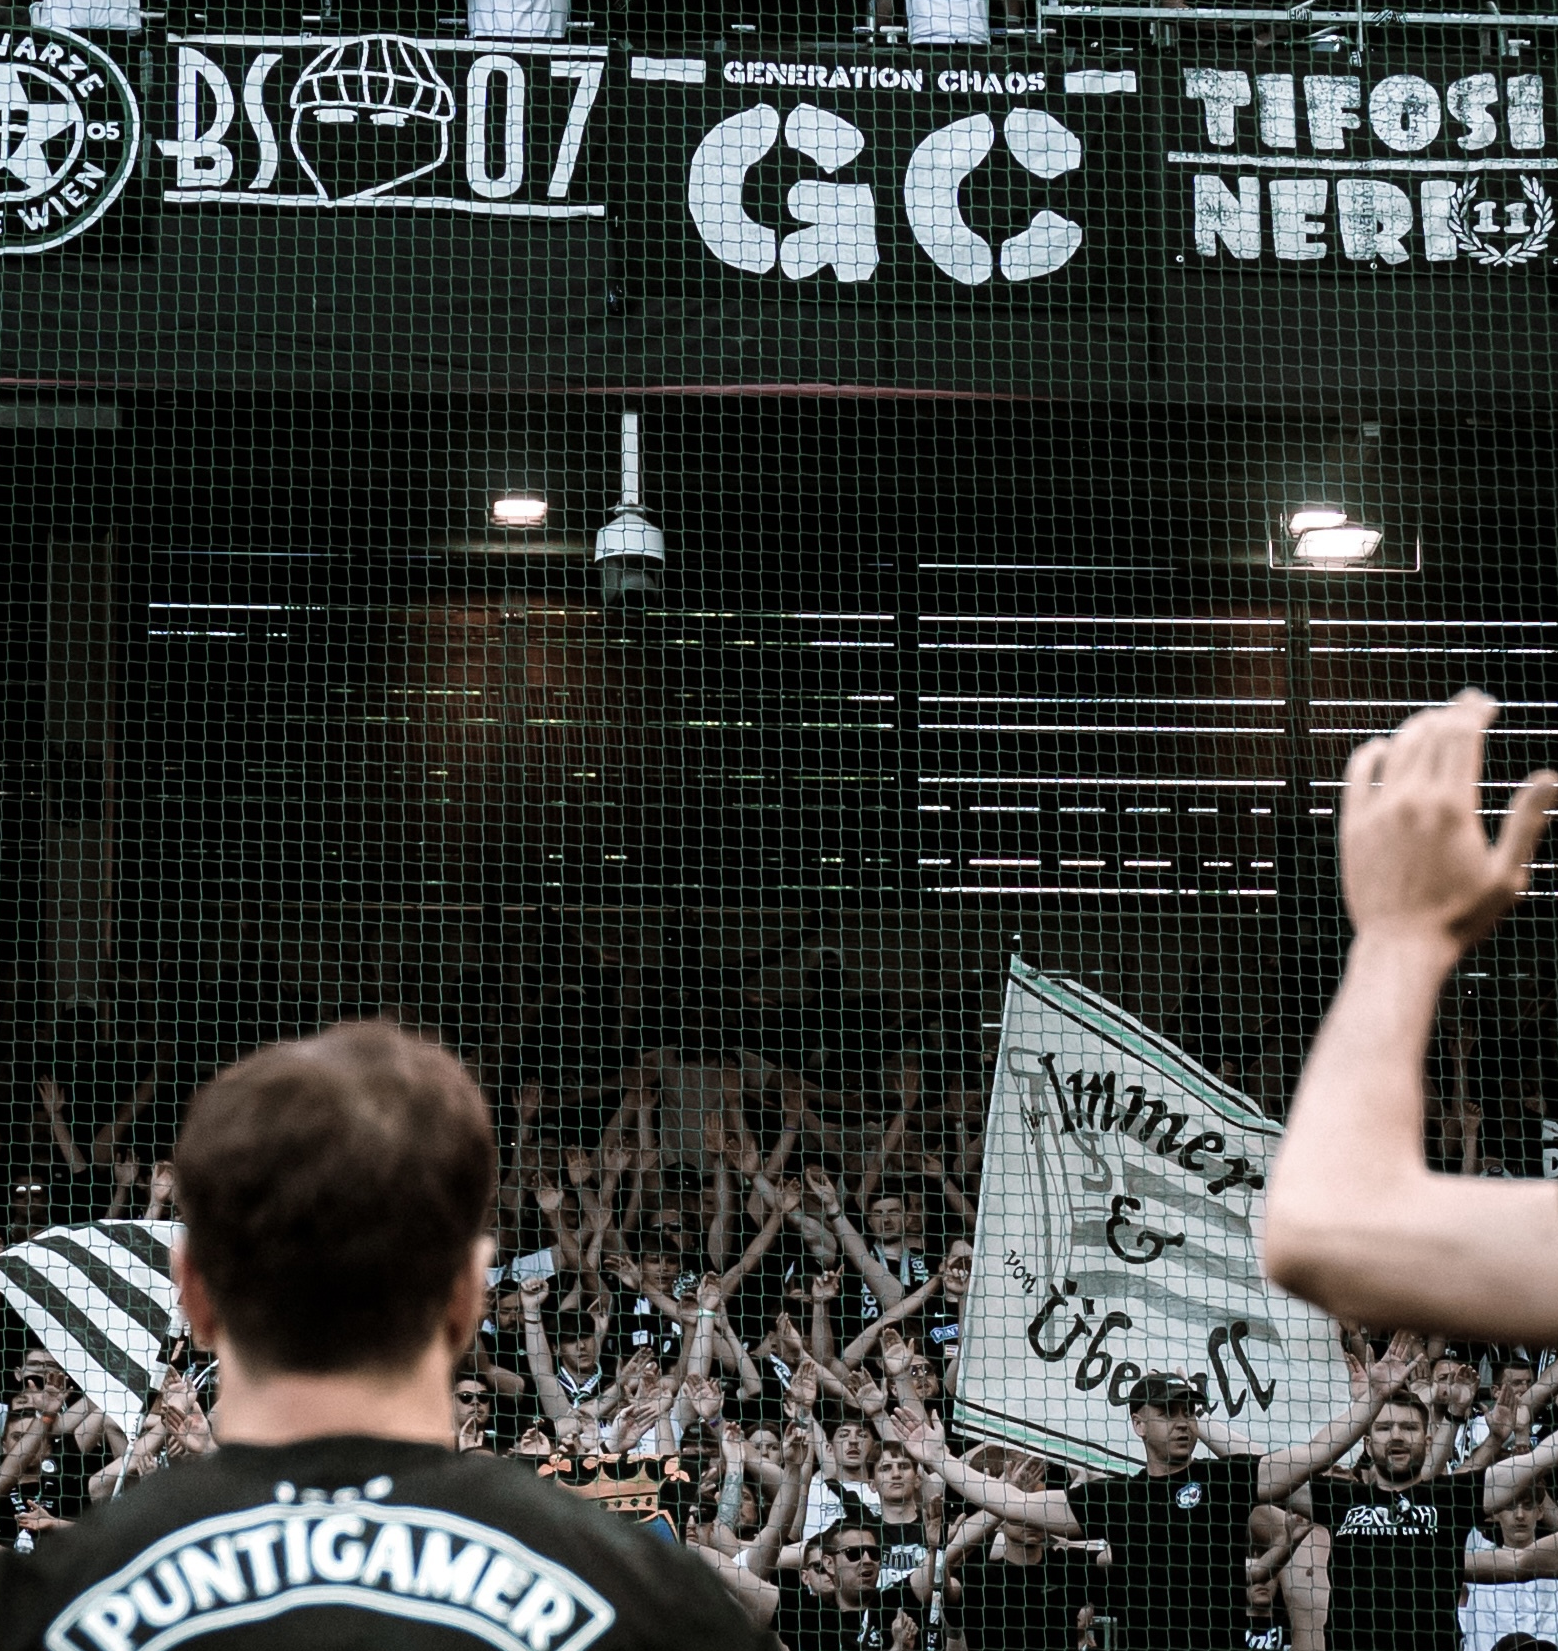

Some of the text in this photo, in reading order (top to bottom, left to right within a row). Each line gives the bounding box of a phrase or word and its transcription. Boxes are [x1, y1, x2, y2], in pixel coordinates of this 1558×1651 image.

[724, 59, 1047, 95] GENERATION CHAOS
[1183, 66, 1545, 151] TIFOSI
[88, 121, 121, 141] 05
[466, 54, 608, 199] 07
[18, 160, 108, 232] WIEN
[688, 102, 1083, 286] GC
[1193, 173, 1458, 266] NERI
[1027, 1278, 1277, 1418] Übell
